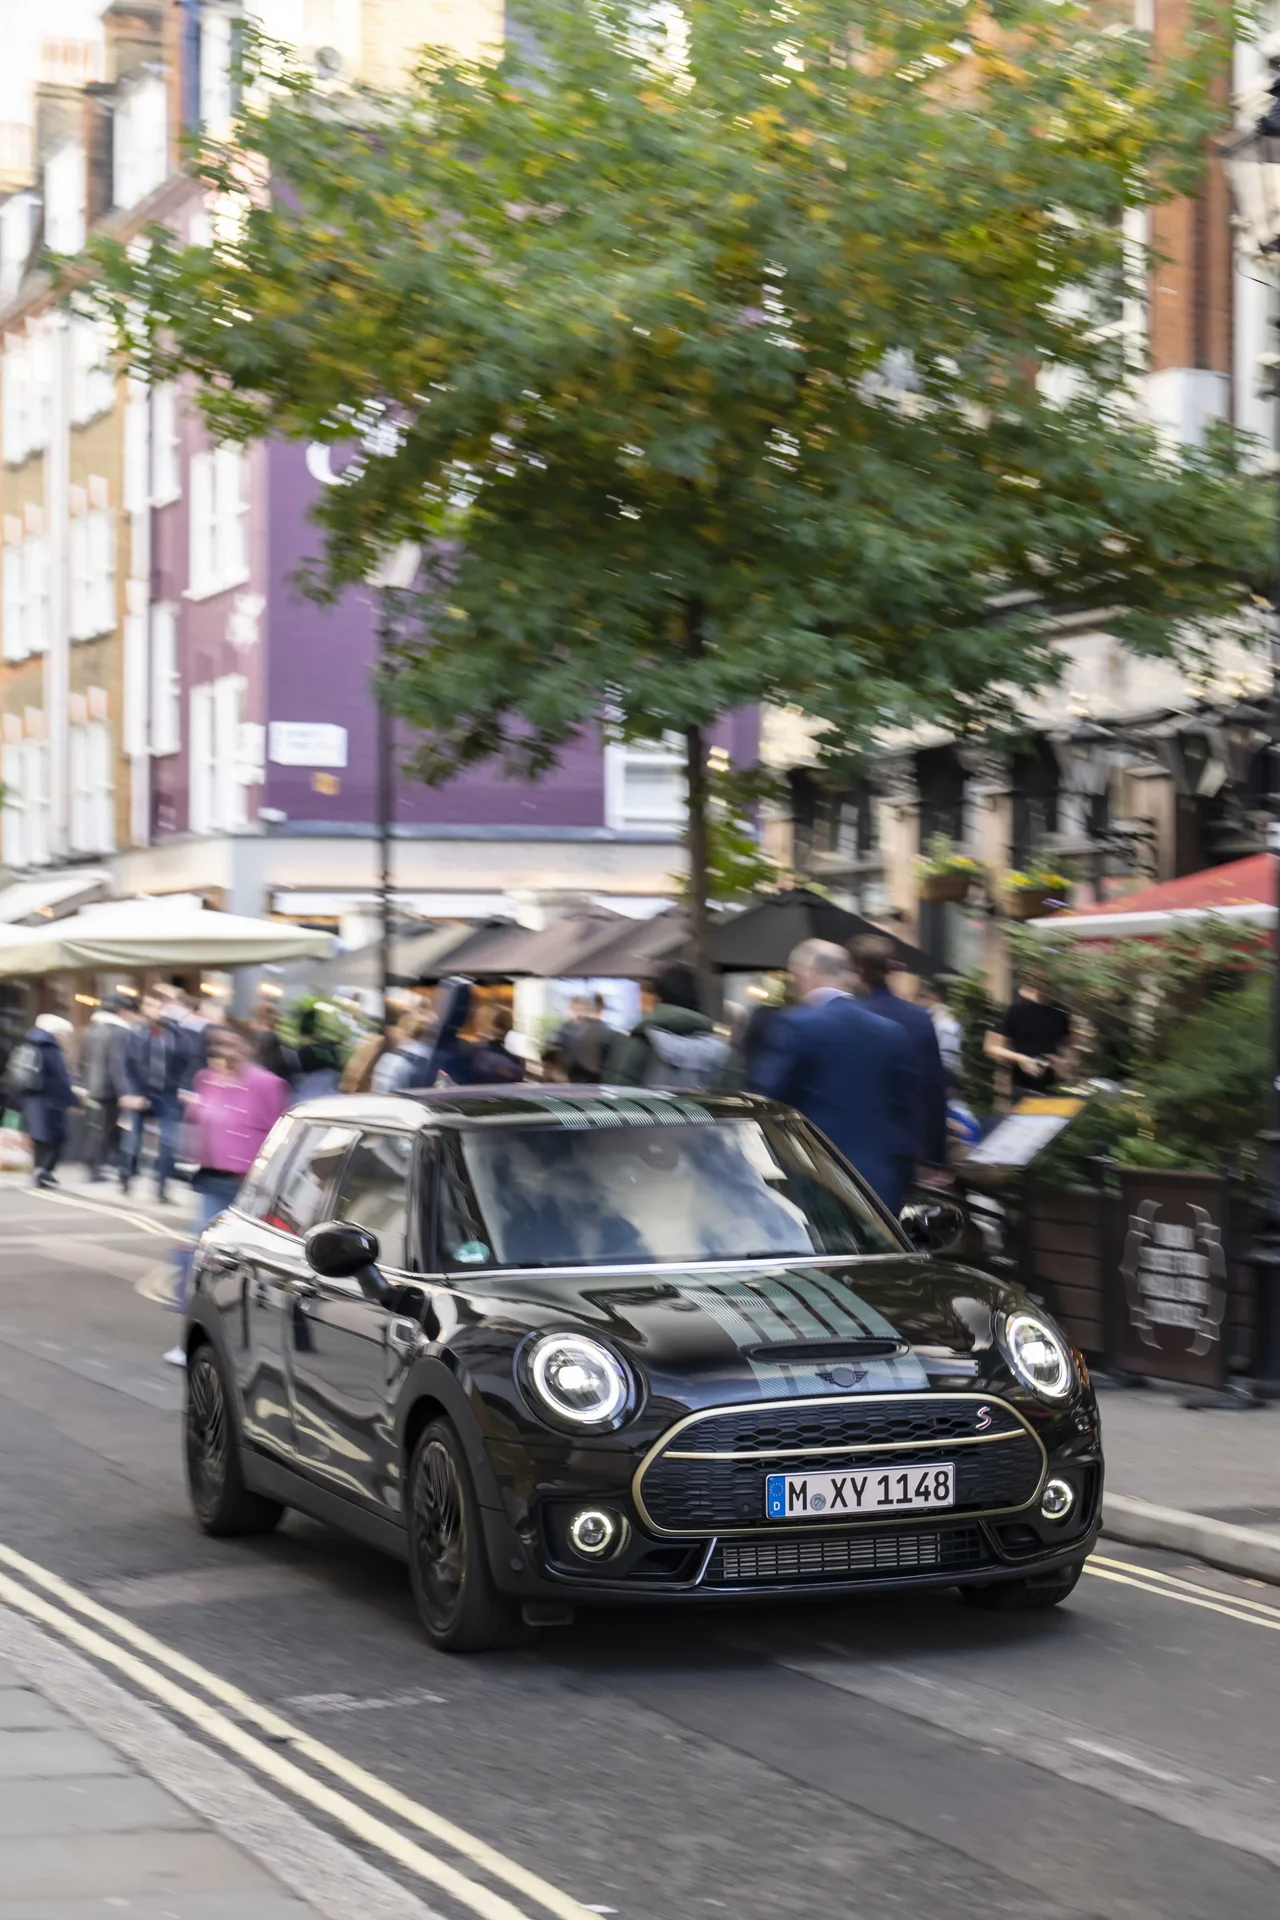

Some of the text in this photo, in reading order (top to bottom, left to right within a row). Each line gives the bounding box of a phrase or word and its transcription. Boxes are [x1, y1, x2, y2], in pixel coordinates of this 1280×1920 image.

[975, 1406, 991, 1430] S
[788, 1471, 950, 1511] M XY 1148
[773, 1501, 781, 1511] D
